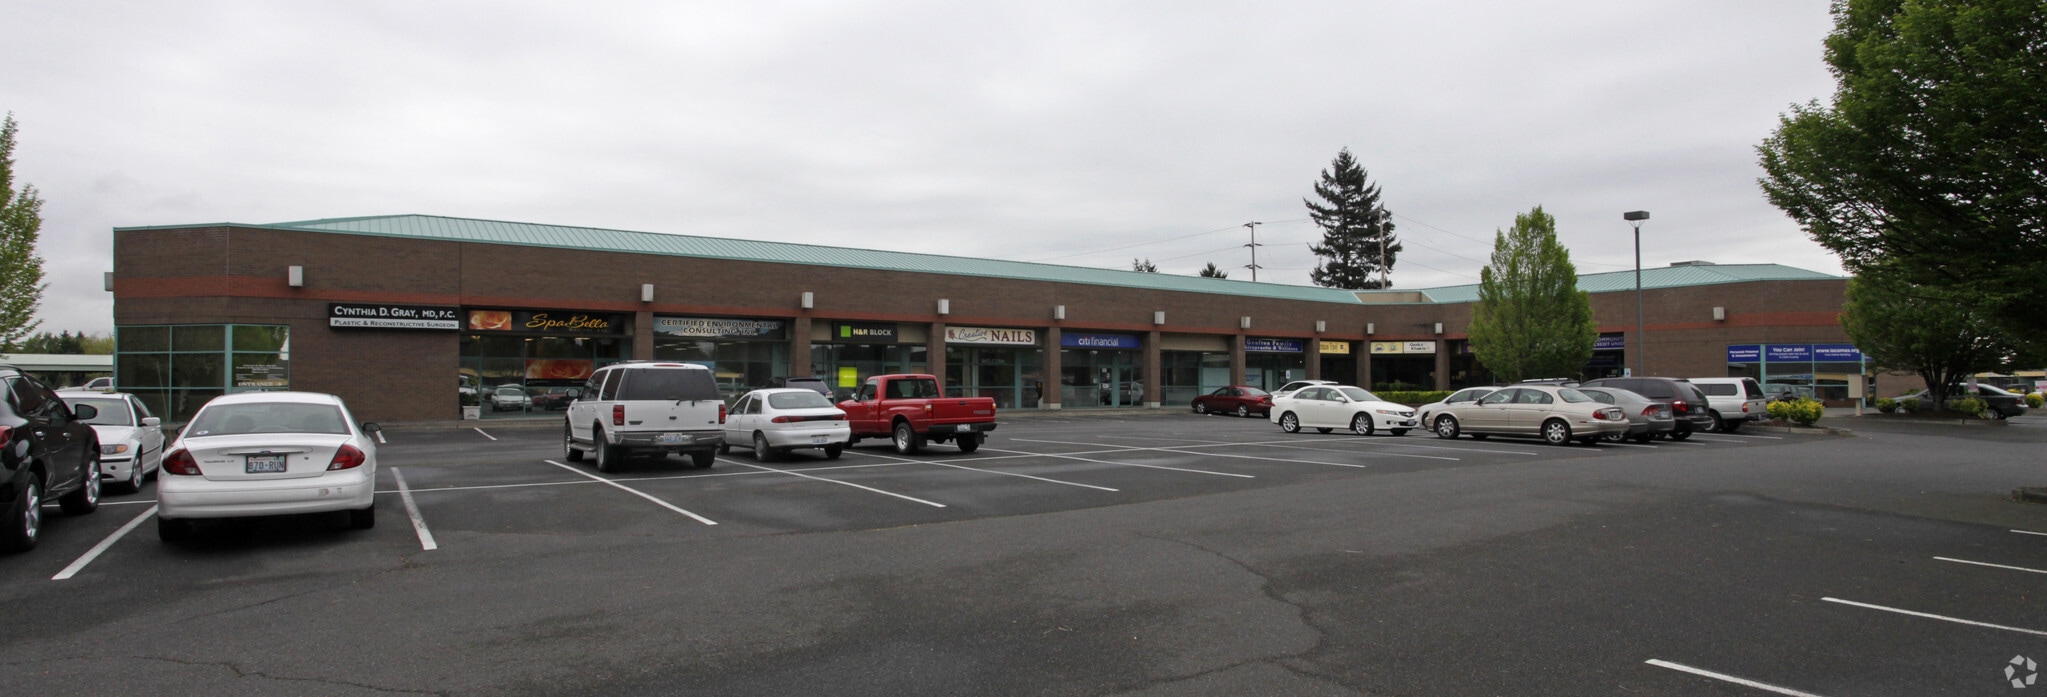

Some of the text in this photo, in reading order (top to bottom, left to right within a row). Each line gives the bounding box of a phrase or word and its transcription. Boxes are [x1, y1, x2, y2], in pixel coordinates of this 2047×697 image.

[334, 306, 376, 316] CYNTHIA
[380, 308, 389, 316] D.
[391, 308, 418, 318] GRAY,
[422, 310, 438, 319] MD,
[706, 320, 778, 329] ENVIRONMENTAL
[683, 327, 740, 336] CONSULTING,
[958, 328, 1032, 342] Creative NAILS
[1078, 337, 1119, 346] citi financial
